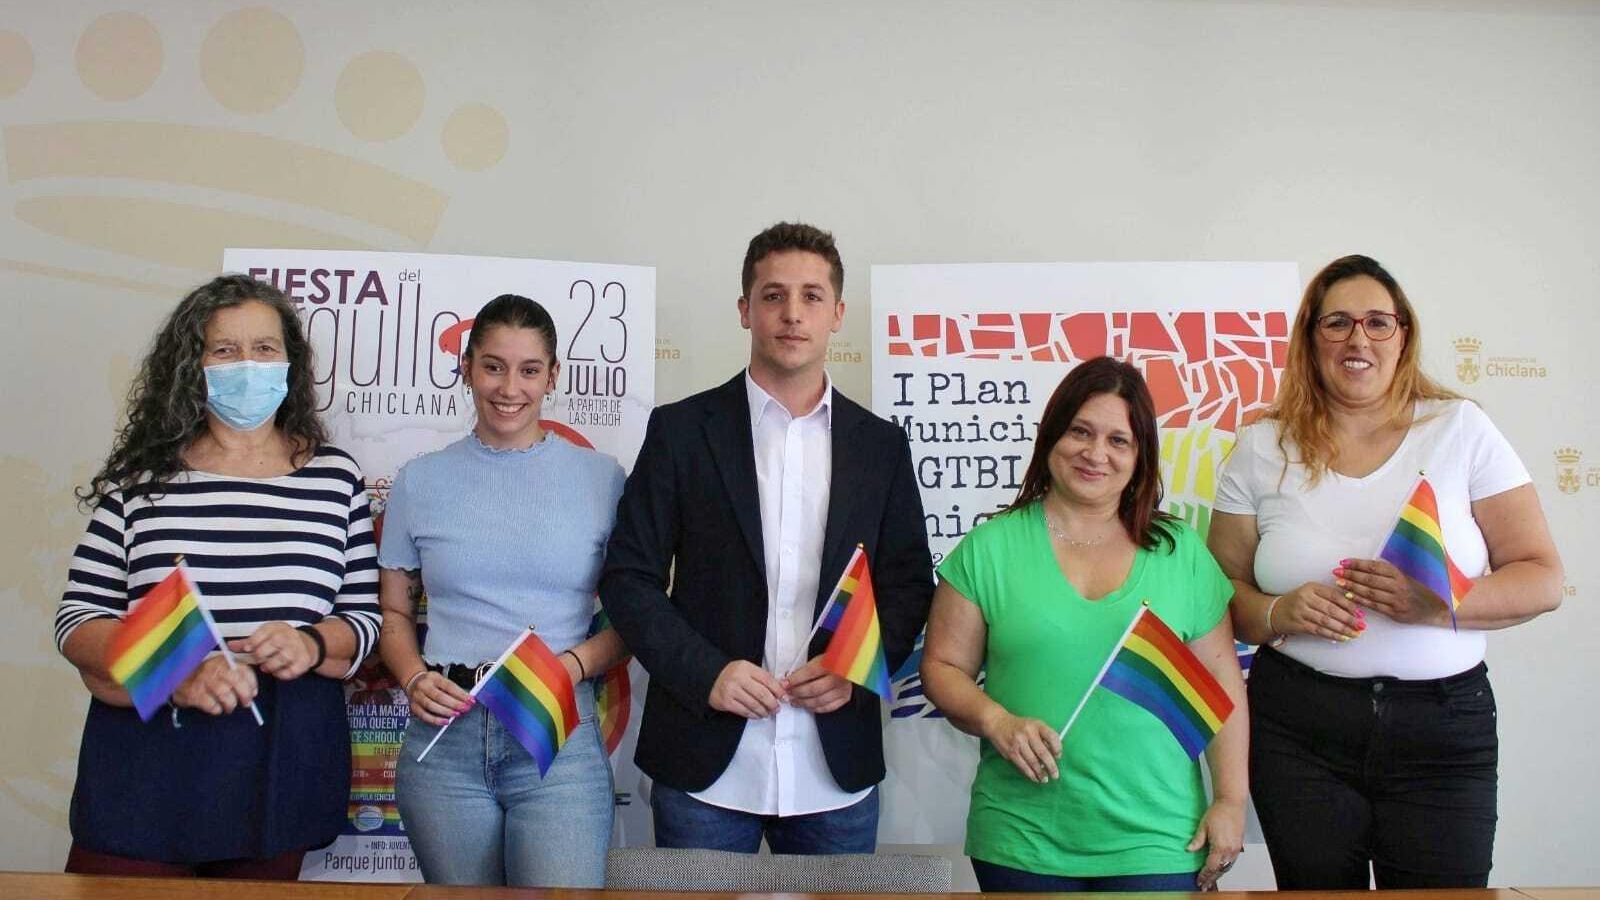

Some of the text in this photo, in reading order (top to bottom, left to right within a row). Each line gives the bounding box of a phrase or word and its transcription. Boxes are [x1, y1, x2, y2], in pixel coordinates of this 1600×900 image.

[248, 268, 421, 306] FIESTA del
[567, 279, 628, 364] 23
[300, 283, 462, 413] gullo
[564, 364, 627, 398] JULIO
[1486, 363, 1548, 378] Chiclana
[893, 373, 1031, 406] I Plan
[346, 391, 457, 416] CHICLANA
[568, 398, 622, 413] A PARTIR DE
[569, 411, 621, 426] LAS 19:00H
[367, 705, 377, 717] LA
[369, 718, 398, 729] QUEEN
[363, 731, 397, 743] SCHOOL
[325, 852, 370, 873] Parque
[371, 853, 405, 874] junto
